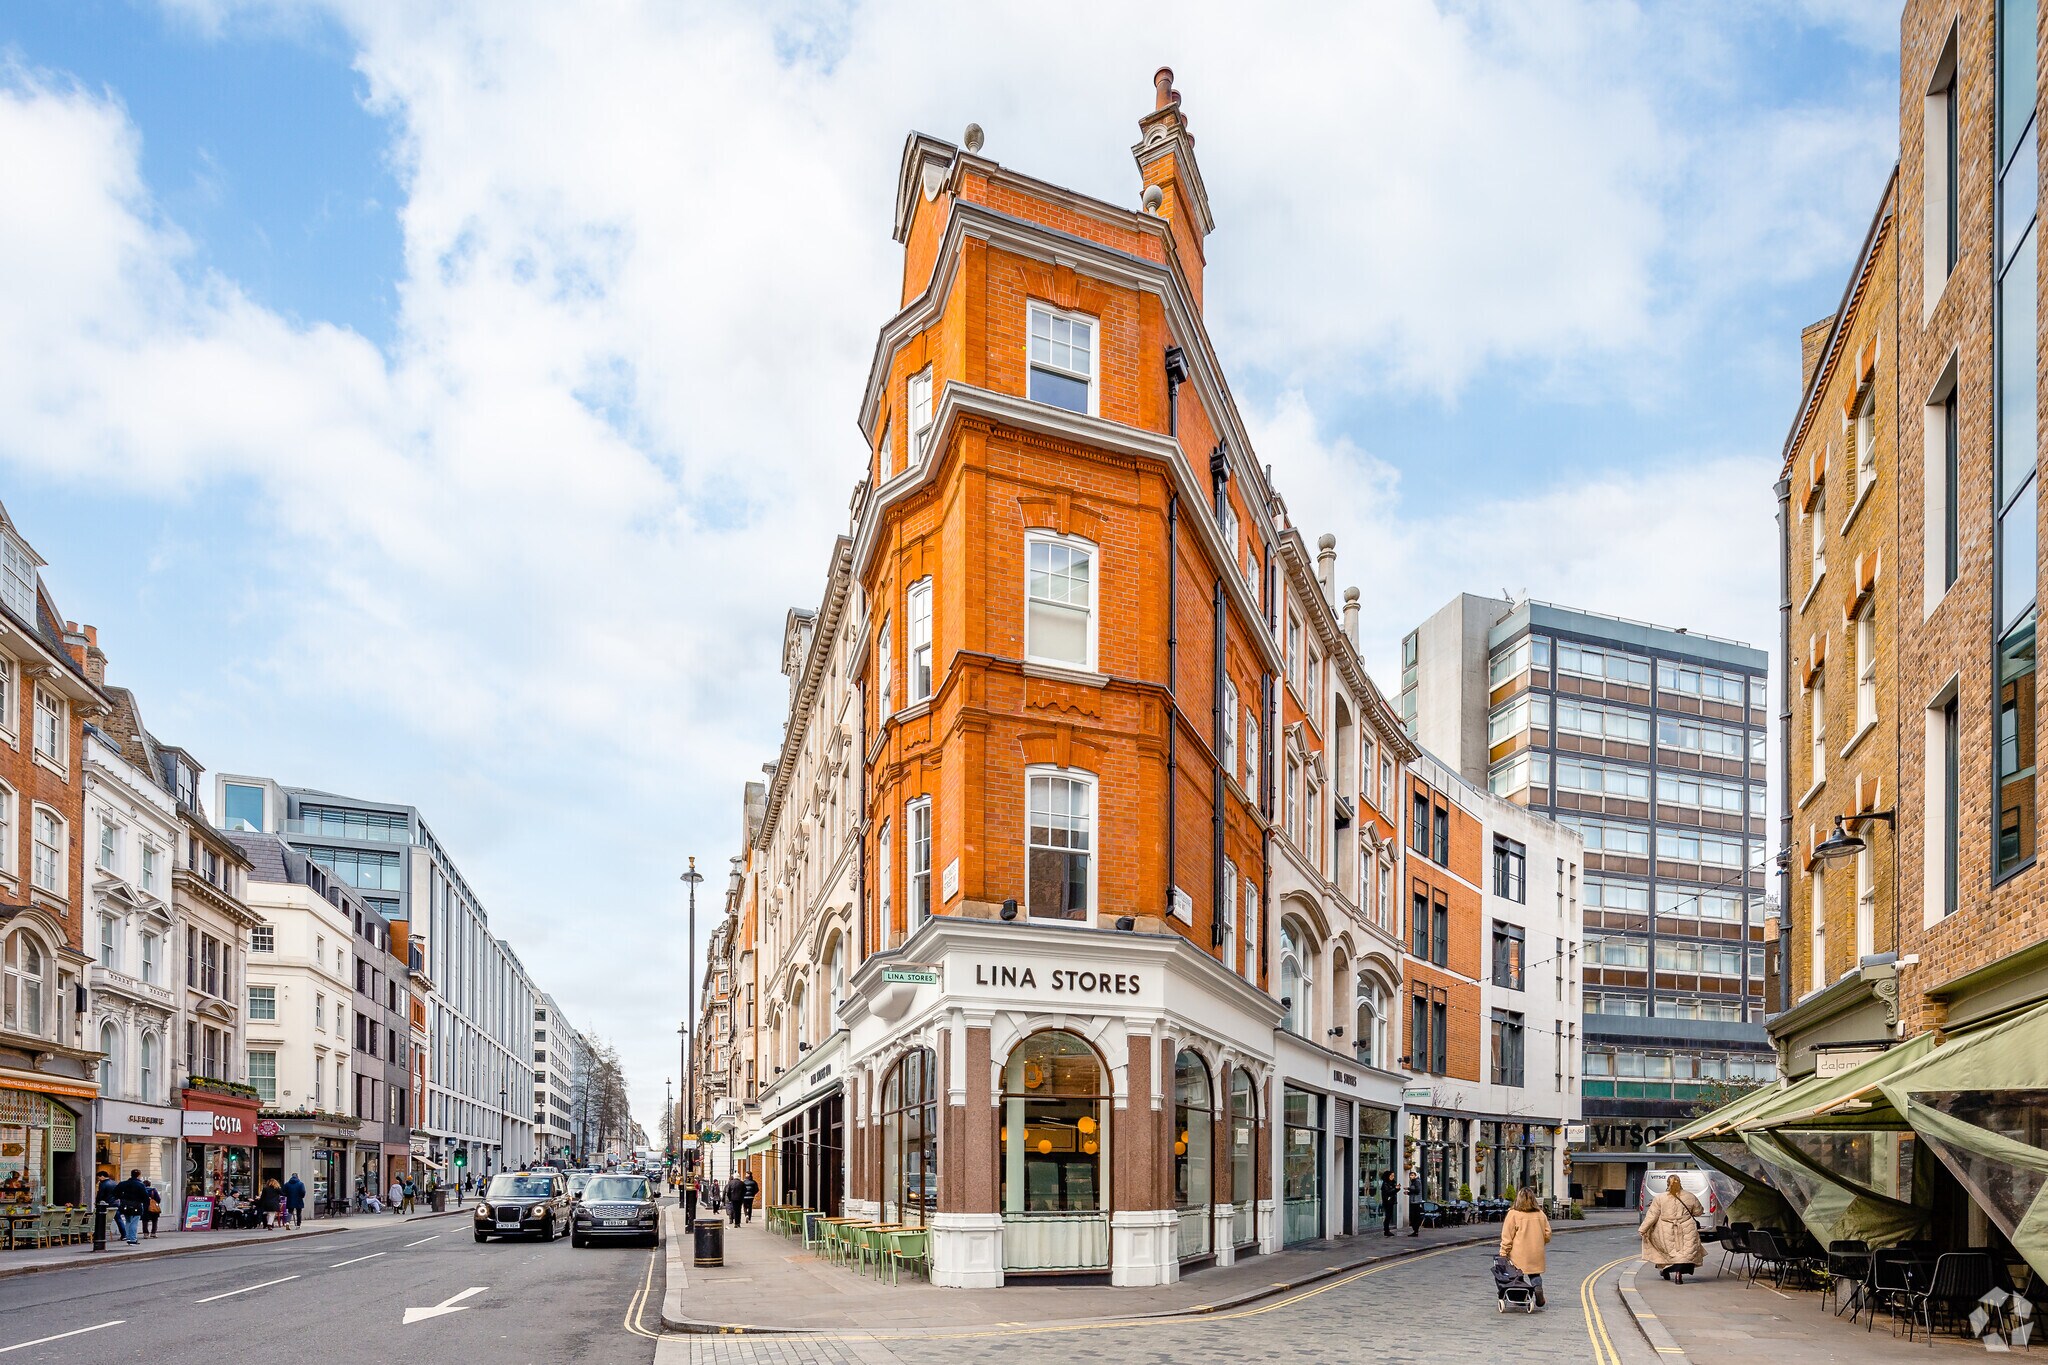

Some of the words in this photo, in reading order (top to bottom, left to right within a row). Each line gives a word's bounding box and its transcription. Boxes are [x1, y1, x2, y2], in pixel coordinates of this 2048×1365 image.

[887, 973, 904, 981] LINA
[907, 974, 933, 982] STORES
[976, 964, 1037, 989] LINA
[1051, 969, 1140, 995] STORES
[1821, 1059, 1860, 1071] delami
[214, 1115, 241, 1134] COSTA
